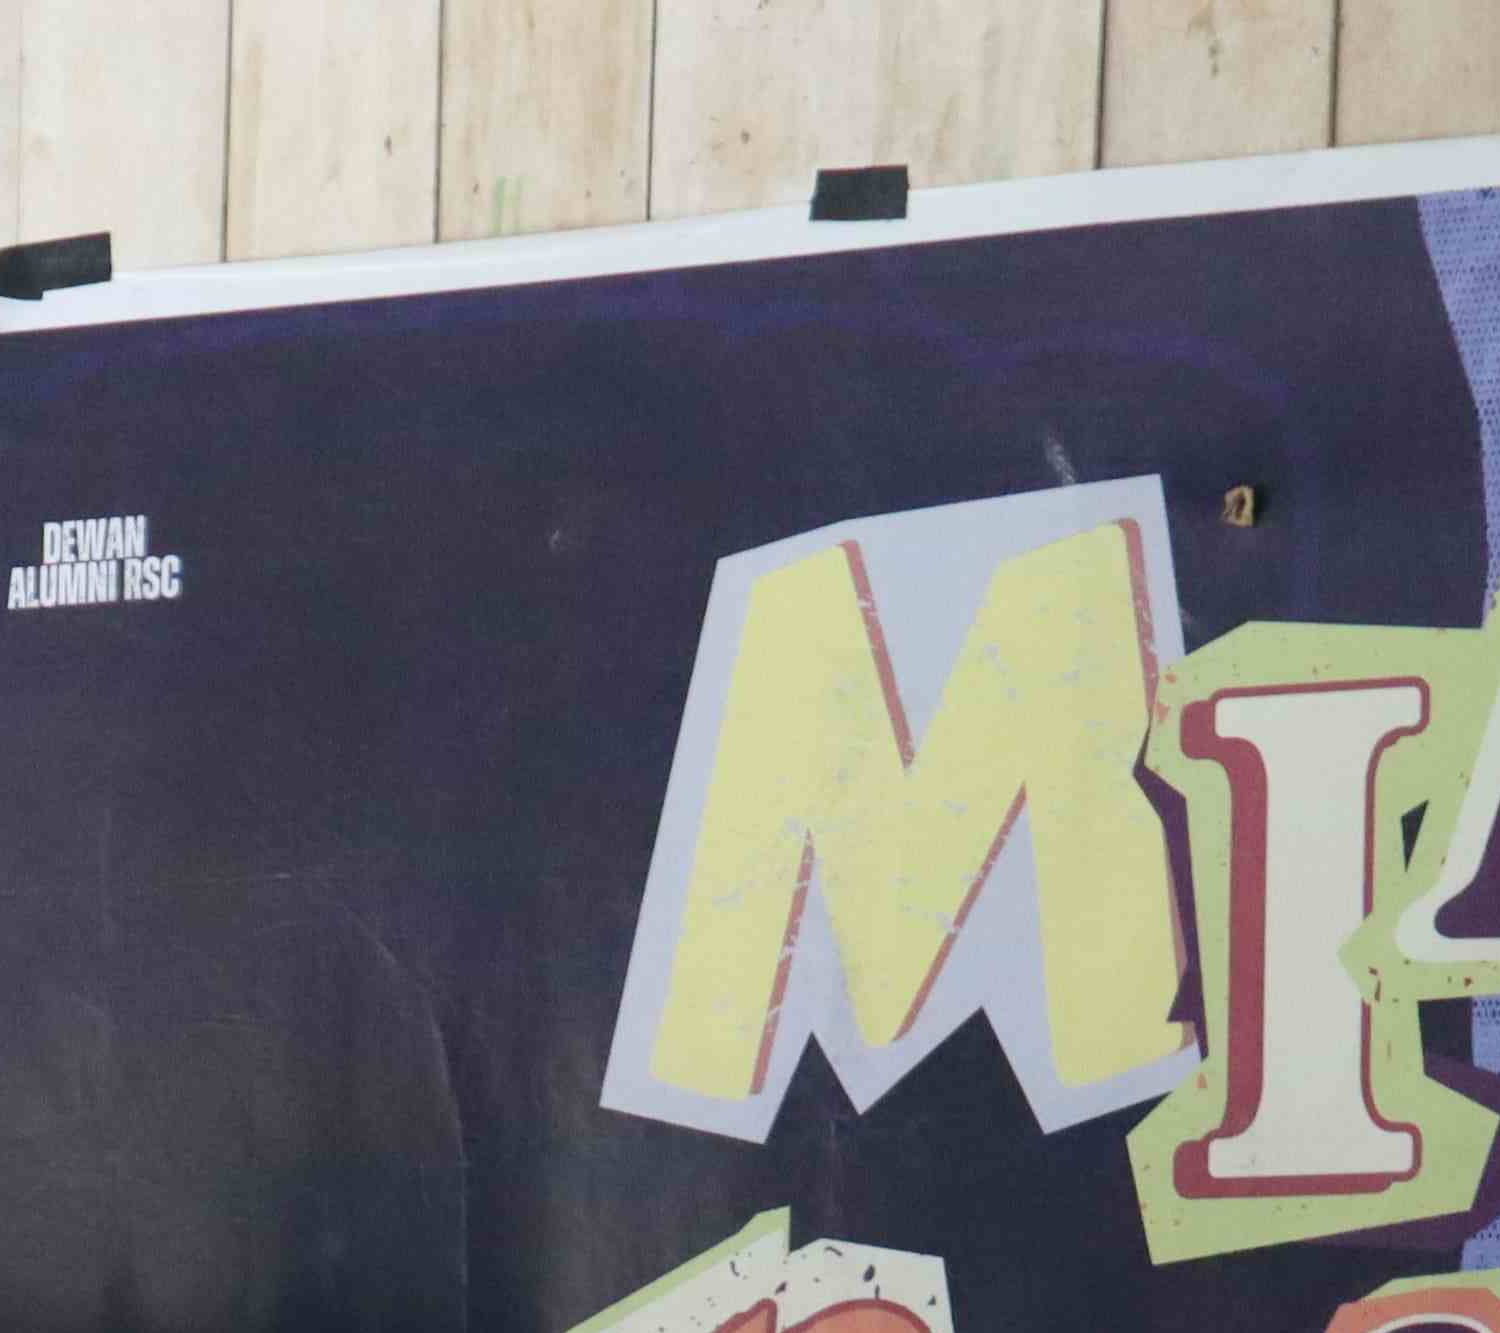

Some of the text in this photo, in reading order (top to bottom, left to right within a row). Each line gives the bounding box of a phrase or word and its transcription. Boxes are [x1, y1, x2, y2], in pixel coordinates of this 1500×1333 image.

[41, 514, 147, 564] DEWAN
[6, 554, 182, 611] ALUMNI RSC
